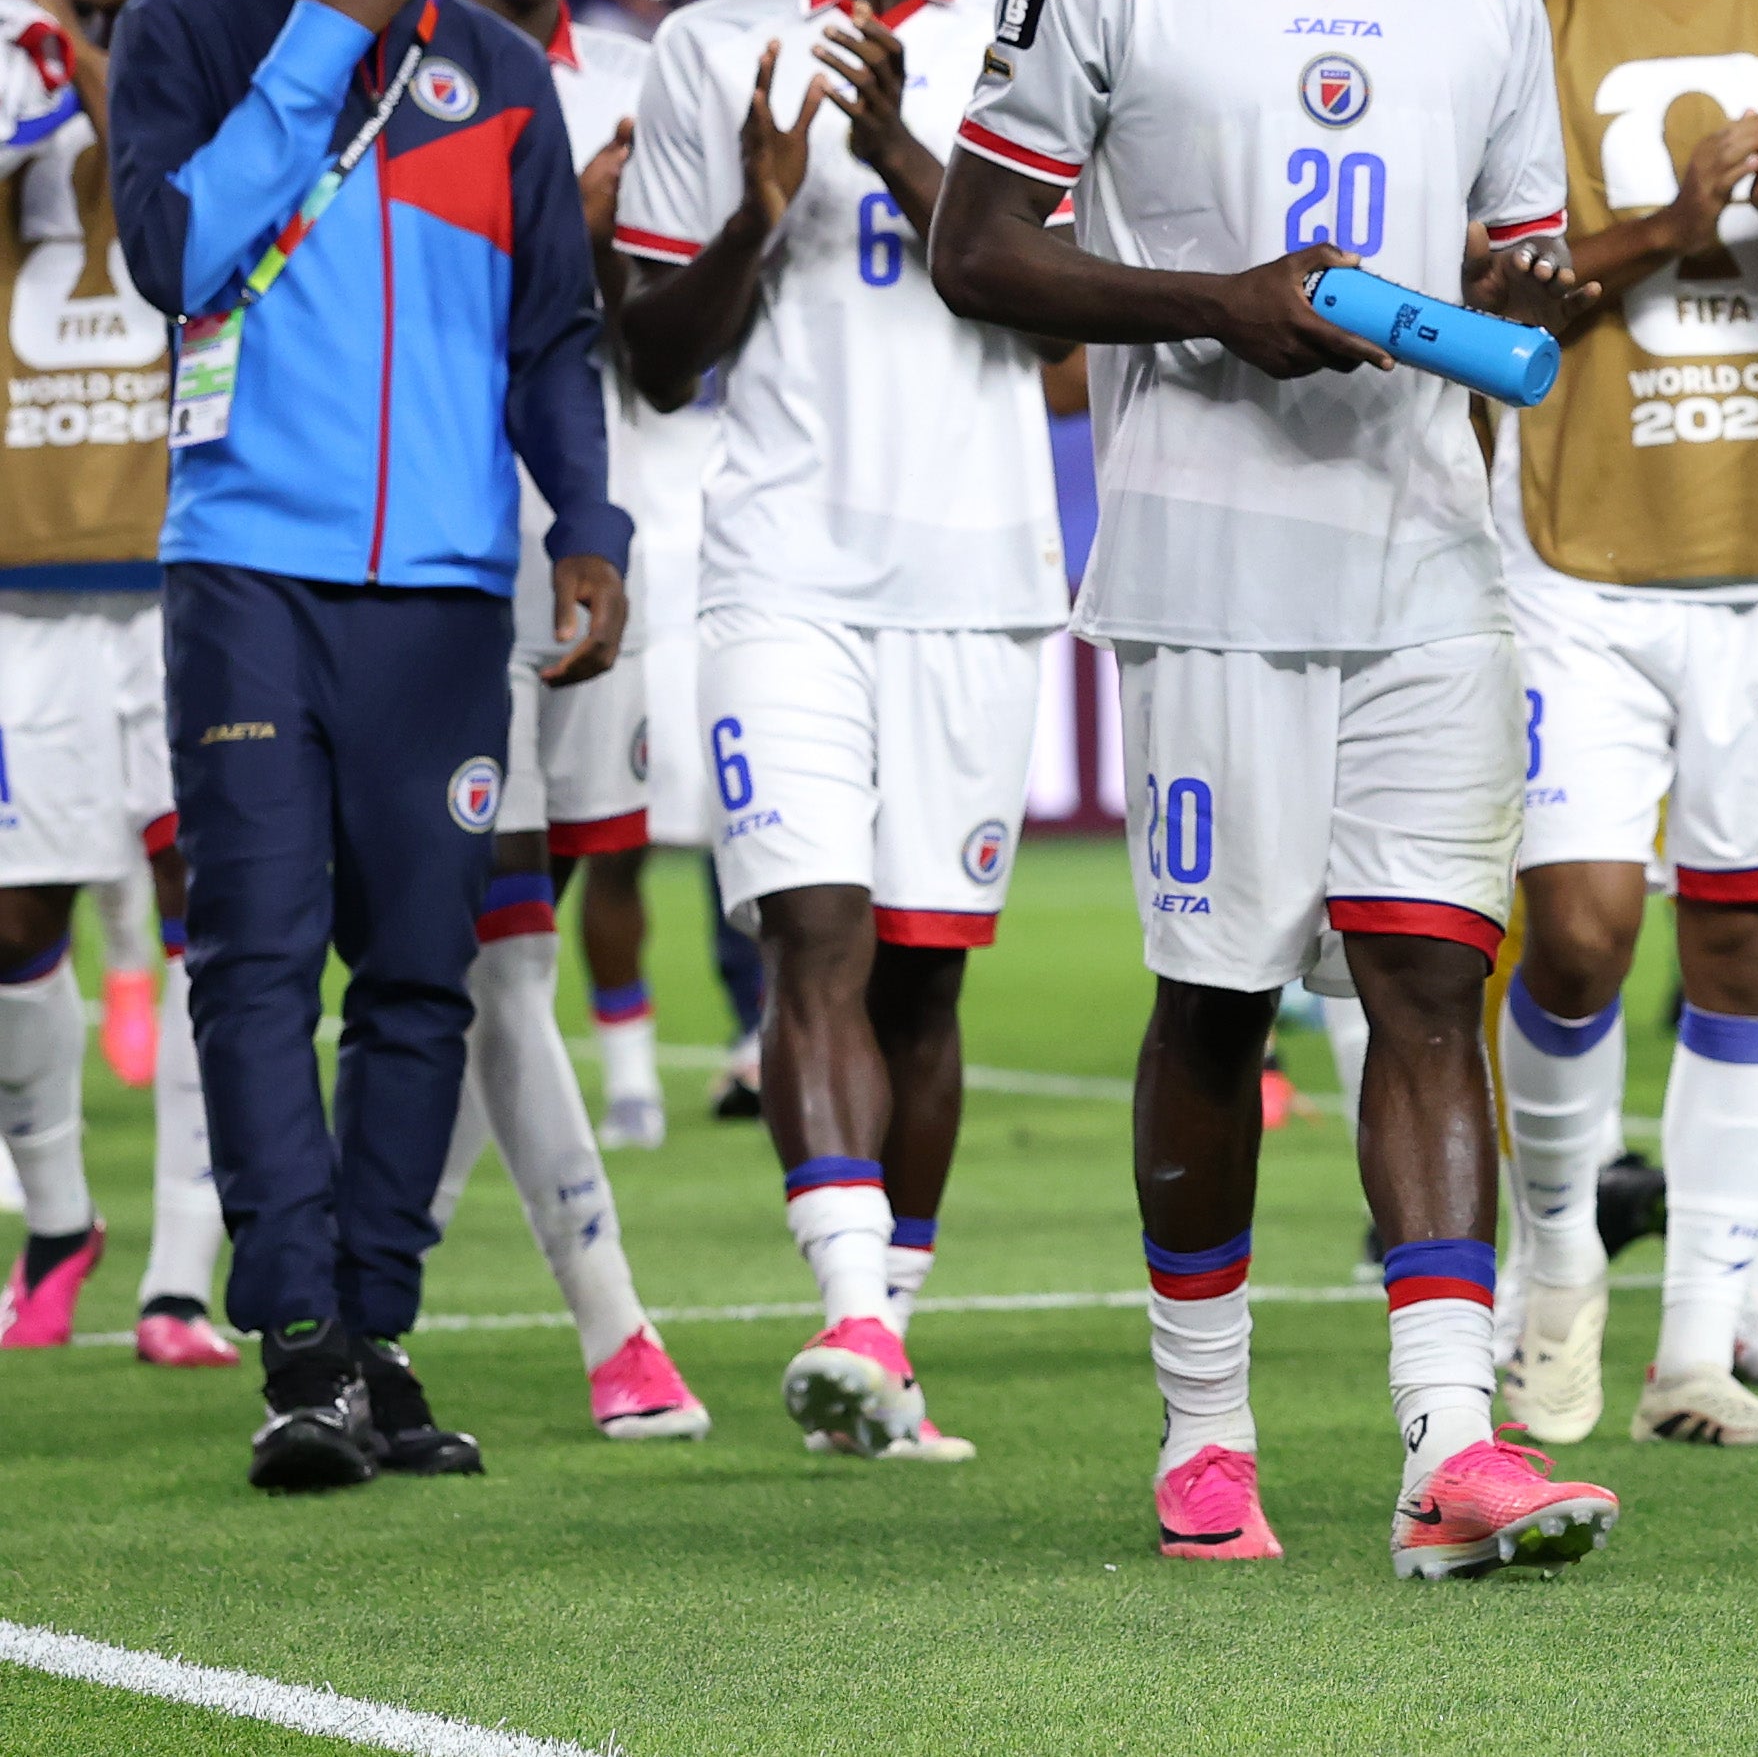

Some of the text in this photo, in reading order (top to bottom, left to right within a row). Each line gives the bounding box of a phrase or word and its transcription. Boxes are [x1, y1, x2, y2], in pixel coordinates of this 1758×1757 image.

[1284, 17, 1383, 38] SAETA
[1286, 148, 1386, 258] 20
[859, 192, 903, 287] 6
[59, 312, 127, 340] FIFA
[1676, 295, 1752, 325] FIFA
[1627, 364, 1742, 399] WORLD
[712, 716, 755, 812] 6
